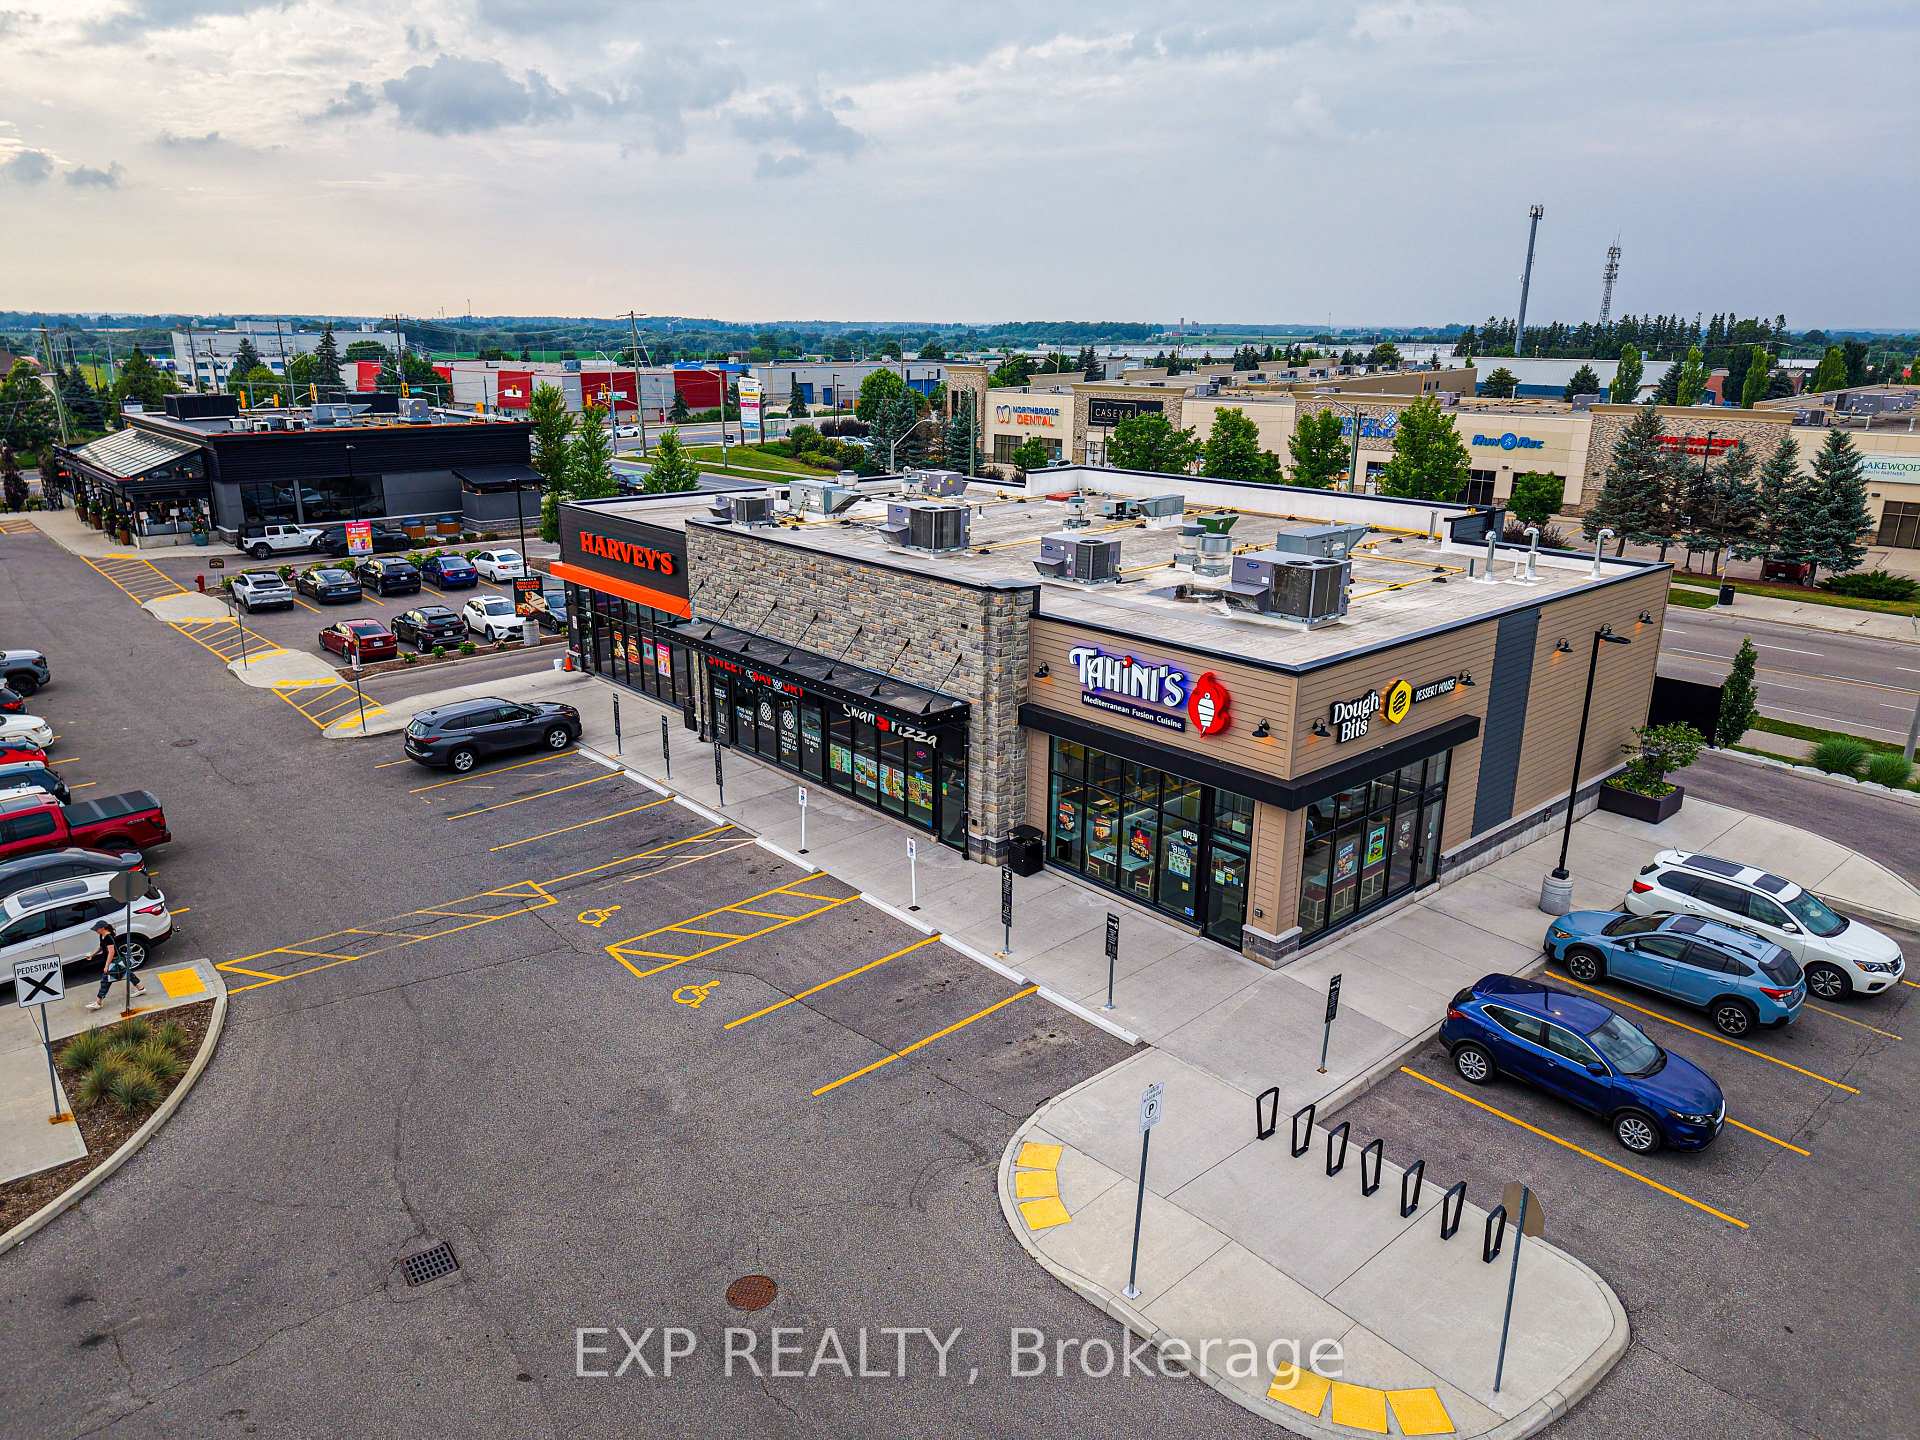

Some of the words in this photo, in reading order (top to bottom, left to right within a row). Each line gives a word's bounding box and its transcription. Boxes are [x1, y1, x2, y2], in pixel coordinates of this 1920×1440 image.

[1012, 405, 1060, 417] NORTHBRIDGE
[1016, 415, 1054, 428] DENTAL
[580, 531, 673, 575] HARVEY'S
[1415, 683, 1439, 702] DESSERT
[1438, 678, 1456, 693] HOUSE
[1083, 694, 1130, 714] Mediterranean
[1131, 708, 1154, 721] Fusion
[1156, 715, 1182, 729] Cuisine
[1333, 691, 1379, 724] Dough
[842, 703, 876, 726] Swan
[891, 721, 937, 749] Pizza
[1340, 719, 1368, 742] Bits
[1182, 829, 1198, 841] OPEN
[17, 961, 58, 976] PEDESTRIAN
